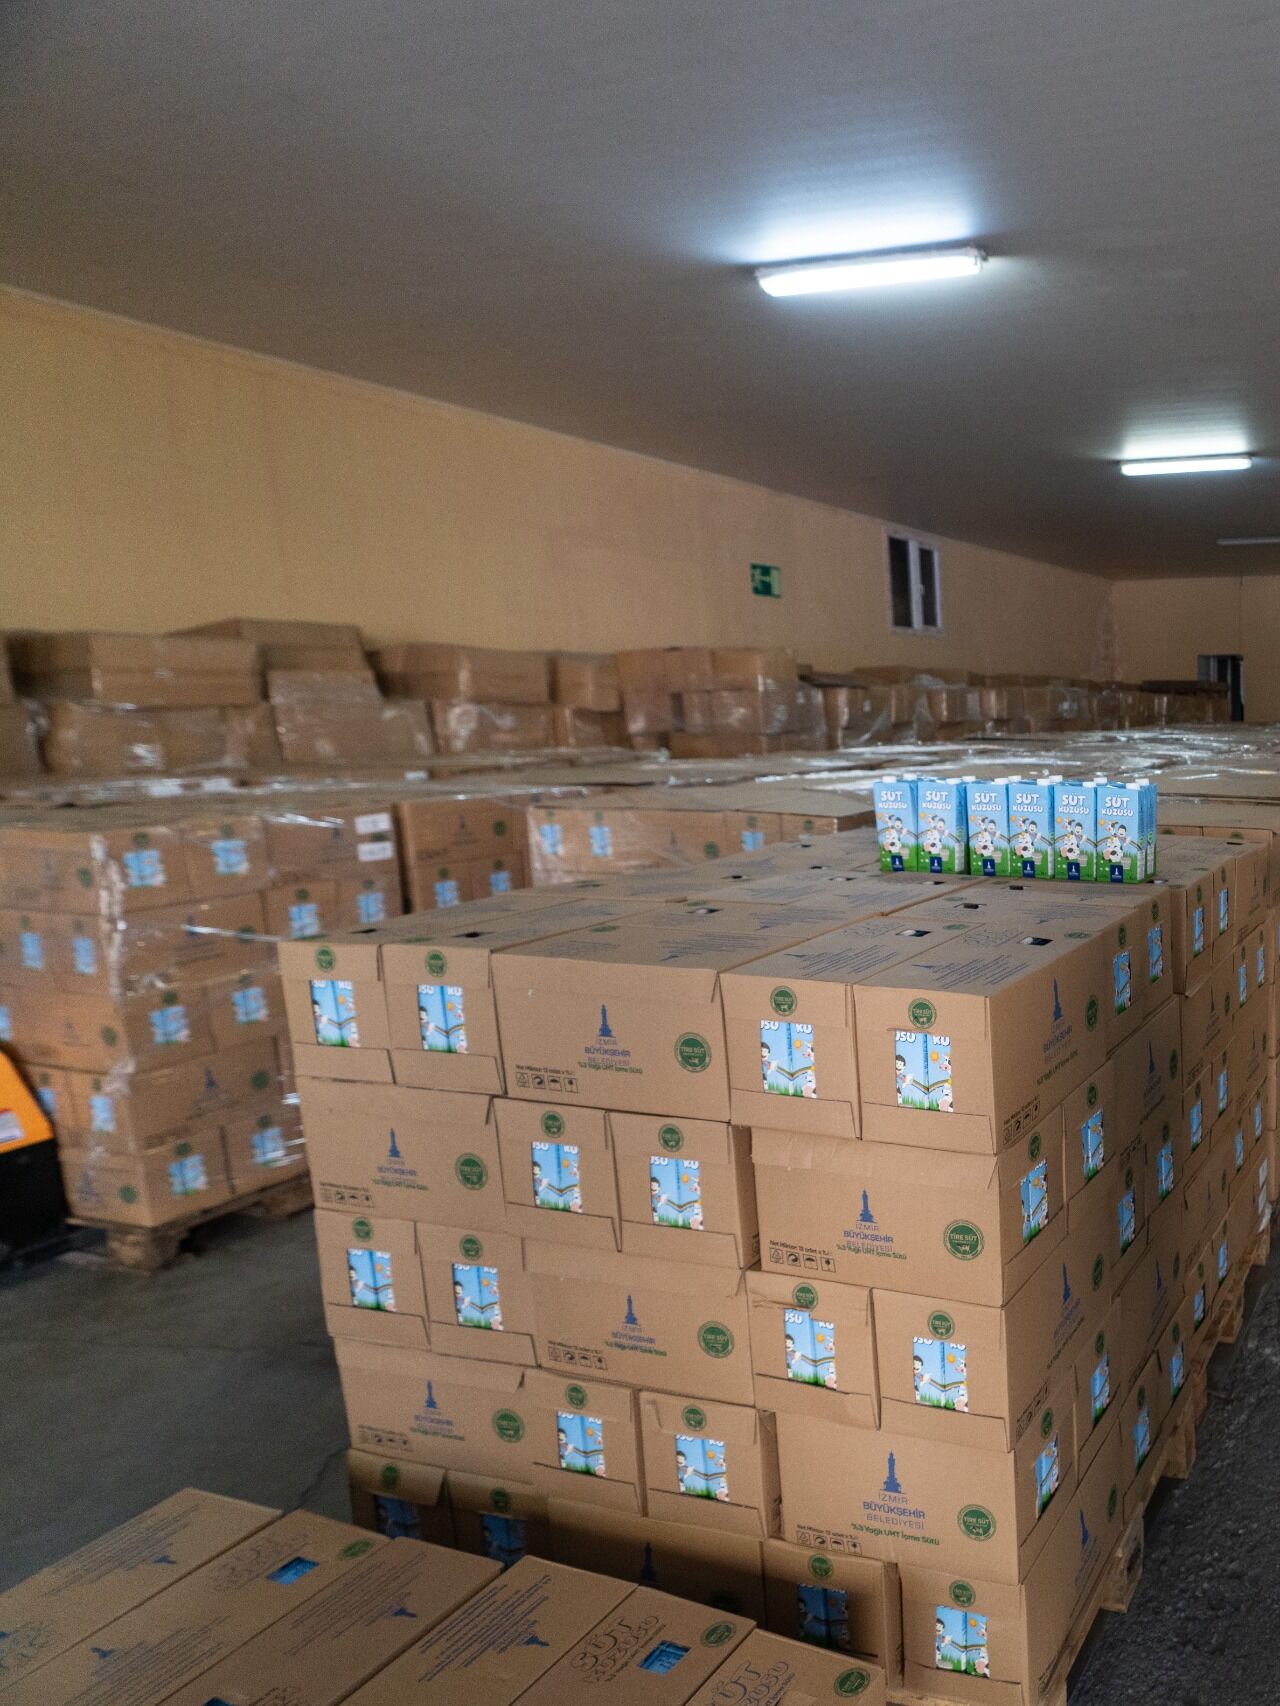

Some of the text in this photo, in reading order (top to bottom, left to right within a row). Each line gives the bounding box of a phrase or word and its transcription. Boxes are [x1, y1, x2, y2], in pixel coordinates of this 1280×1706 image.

[1016, 791, 1039, 804] SÜT
[1062, 792, 1086, 806] SÜT
[1105, 794, 1130, 808] SÜT
[1012, 805, 1043, 813] KUZUSU
[1058, 806, 1090, 815] KUZUSU
[1101, 808, 1134, 817] KUZUSU
[844, 1230, 893, 1243] BÜYÜKŞEHİR
[878, 1492, 908, 1505] İZMİR
[863, 1501, 926, 1520] BÜYÜKŞEHİR
[866, 1512, 925, 1530] BELEDİYESİ
[864, 1525, 882, 1536] Yağlı
[883, 1528, 900, 1537] UHT
[921, 1536, 940, 1545] Sütü
